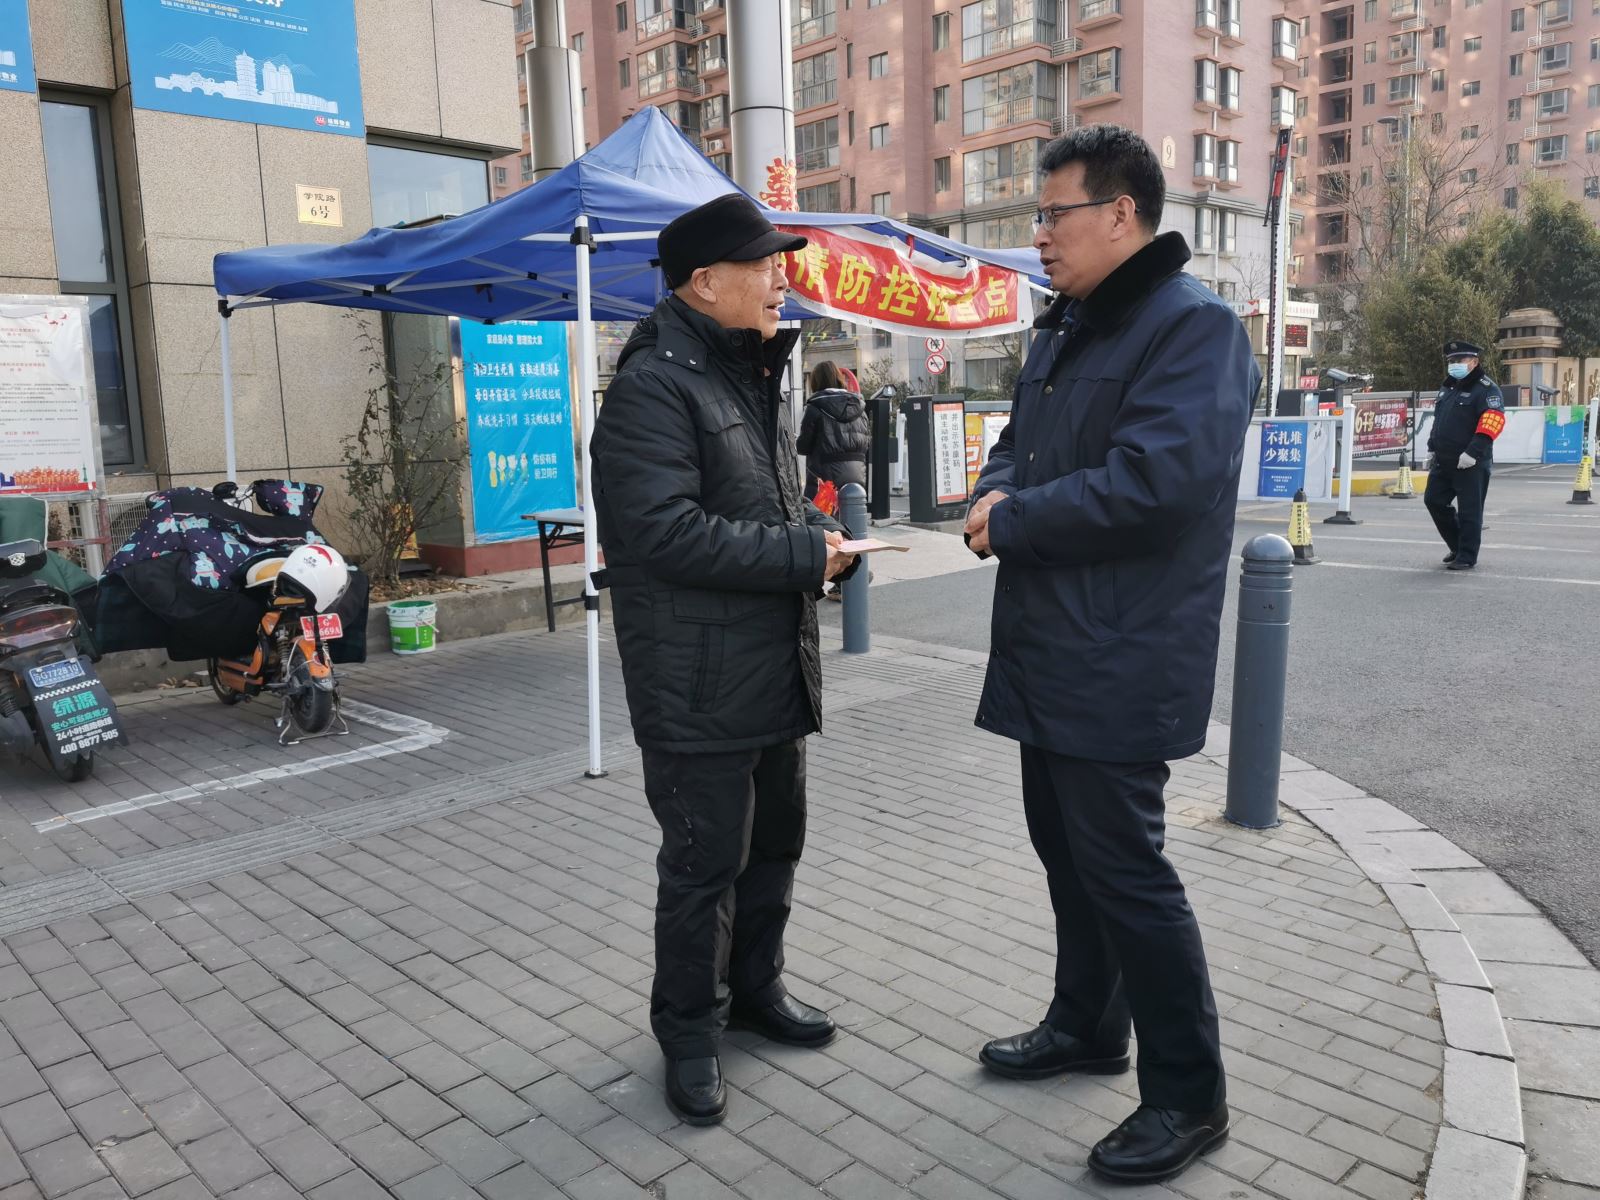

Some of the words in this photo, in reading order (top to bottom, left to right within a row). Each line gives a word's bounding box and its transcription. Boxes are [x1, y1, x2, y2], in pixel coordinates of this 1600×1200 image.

[304, 192, 336, 203] 学院路
[310, 205, 330, 219] 6号
[779, 241, 1009, 322] 情防控检查点
[1265, 431, 1303, 445] 不扎堆
[1264, 448, 1301, 463] 少聚集
[52, 690, 98, 718] 绿源
[60, 743, 78, 754] 400
[78, 734, 100, 749] 8877
[101, 729, 119, 741] 505
